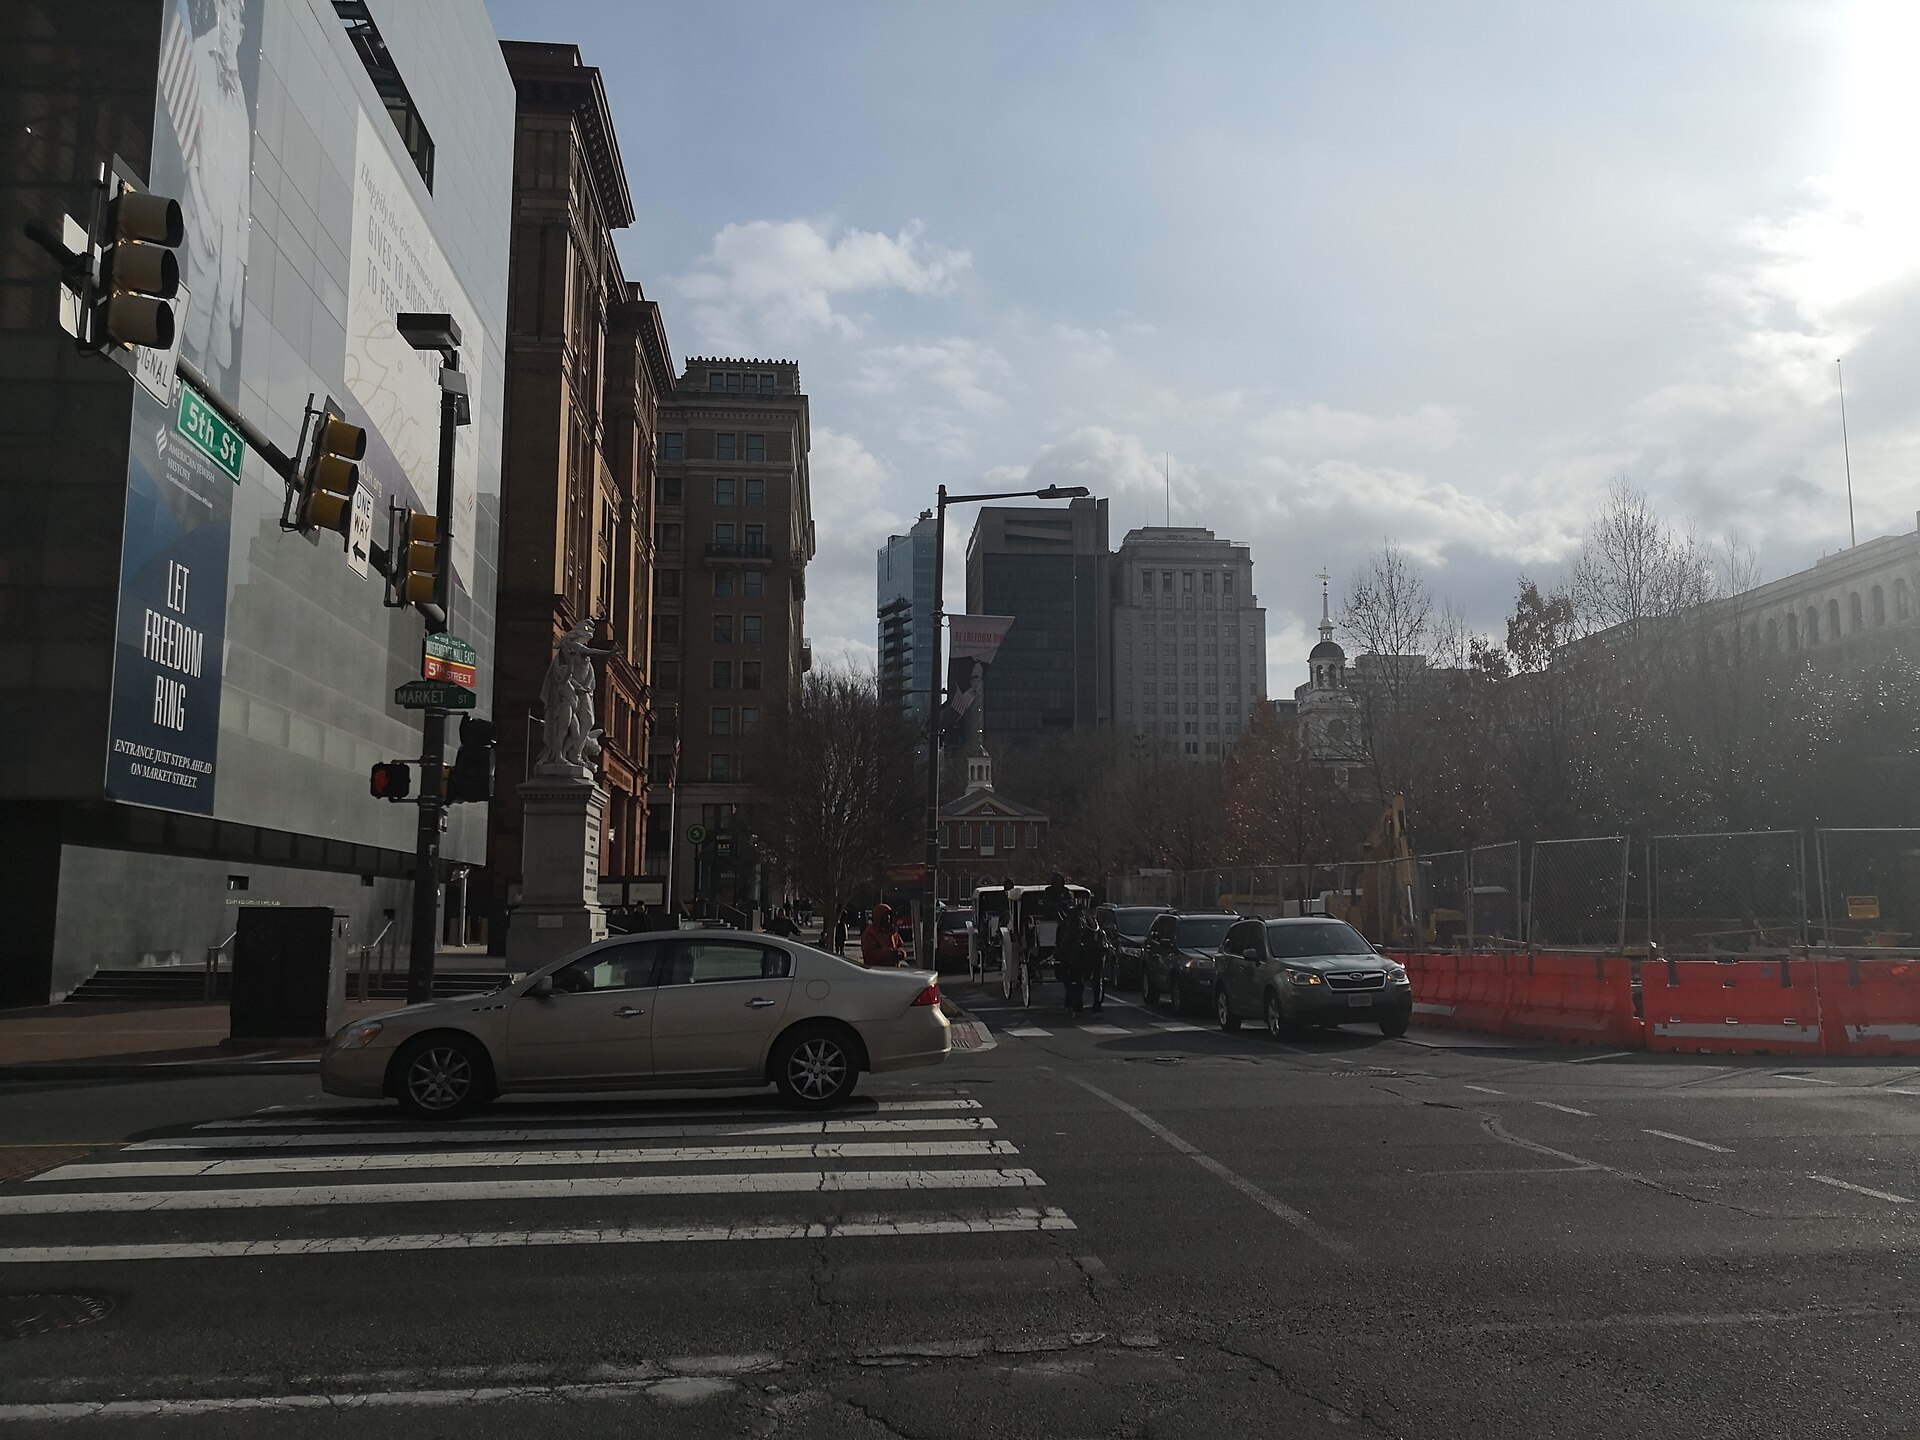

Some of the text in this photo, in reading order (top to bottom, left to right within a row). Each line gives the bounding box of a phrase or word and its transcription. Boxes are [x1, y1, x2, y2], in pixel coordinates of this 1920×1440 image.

[360, 161, 389, 224] Happily
[388, 211, 400, 237] the
[368, 214, 392, 272] GIVES
[394, 253, 404, 290] TO
[367, 256, 378, 295] TO
[187, 402, 215, 448] 5th
[219, 432, 236, 467] St
[167, 457, 191, 481] HISTORY
[168, 443, 197, 470] AMERICAN
[356, 491, 371, 519] ONE
[354, 512, 370, 541] WAY
[167, 559, 190, 615] LET
[143, 608, 204, 679] FREEDOM
[464, 650, 476, 666] EAST
[428, 662, 472, 684] 5TH STREET
[153, 675, 187, 732] RING
[397, 690, 468, 704] MARKET ST
[114, 739, 213, 775] ENTRANCE JUST STEPS AHEAD
[131, 762, 143, 776] ON
[141, 765, 173, 783] MARKET
